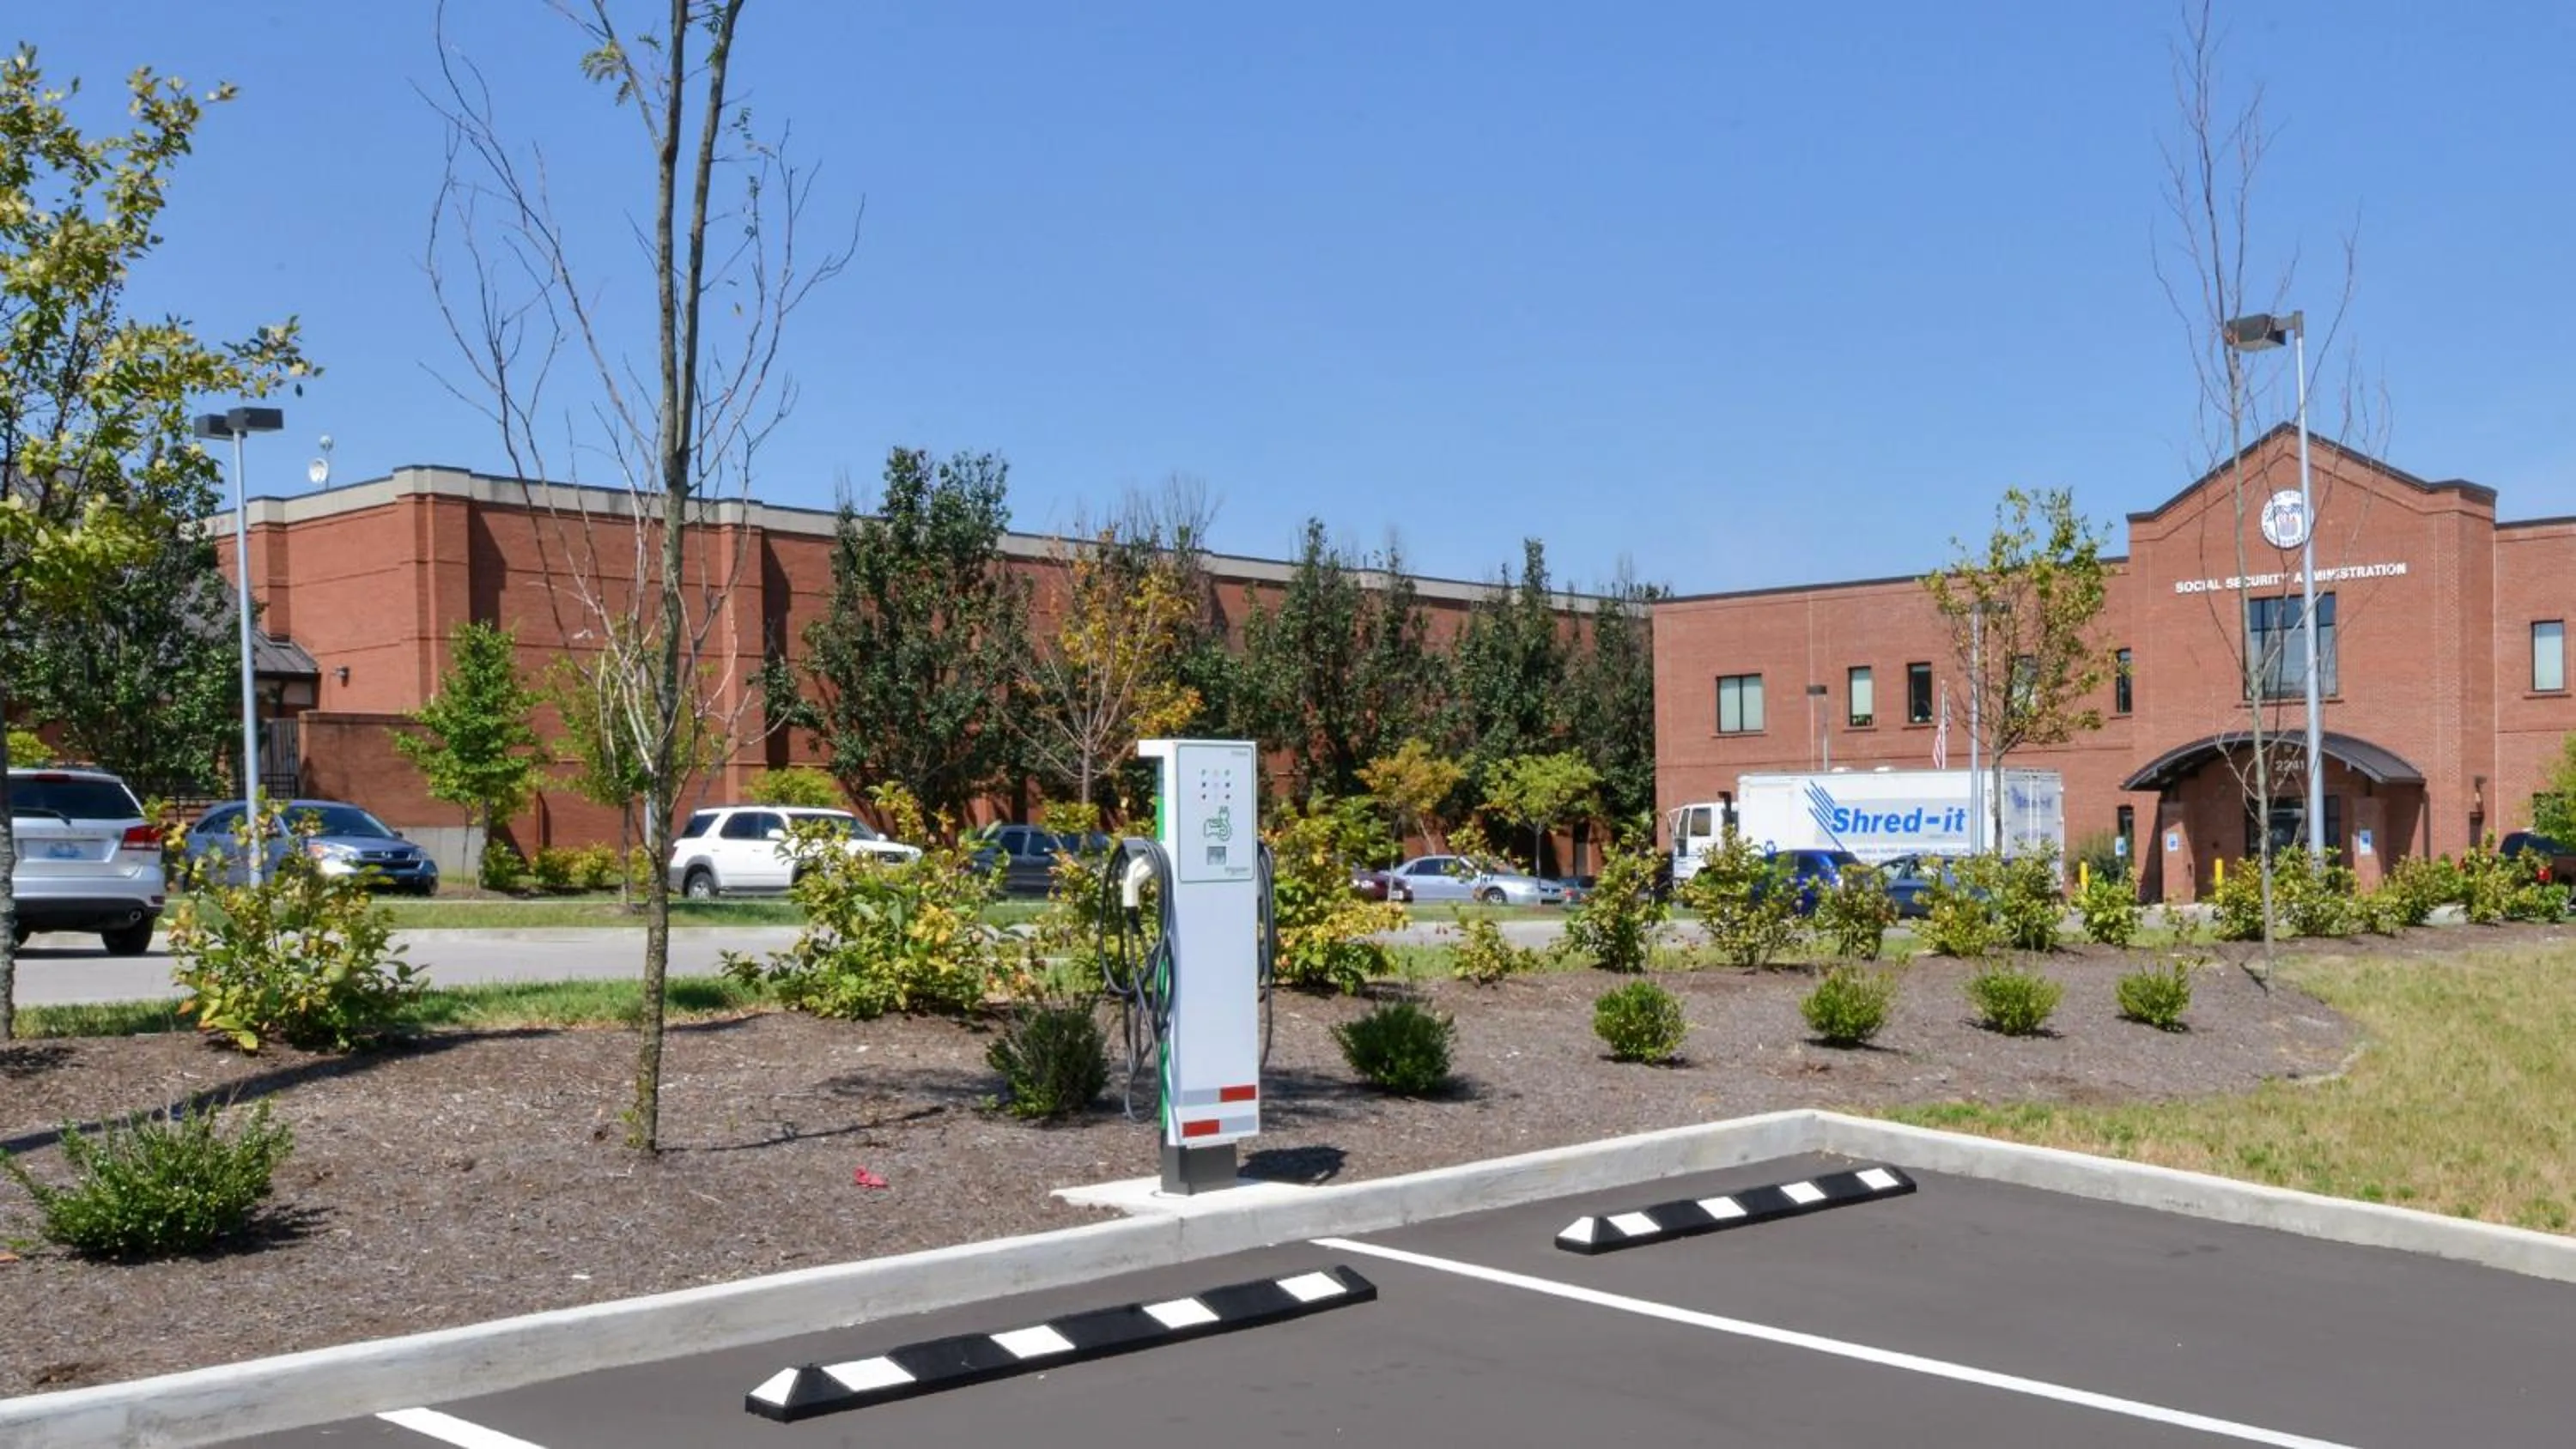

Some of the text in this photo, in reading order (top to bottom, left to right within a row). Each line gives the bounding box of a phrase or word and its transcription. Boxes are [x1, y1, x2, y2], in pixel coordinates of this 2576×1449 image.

[2175, 578, 2222, 593] SOCIAL
[2293, 562, 2407, 584] AMINISTRATION
[1830, 807, 1965, 834] Shred-it
